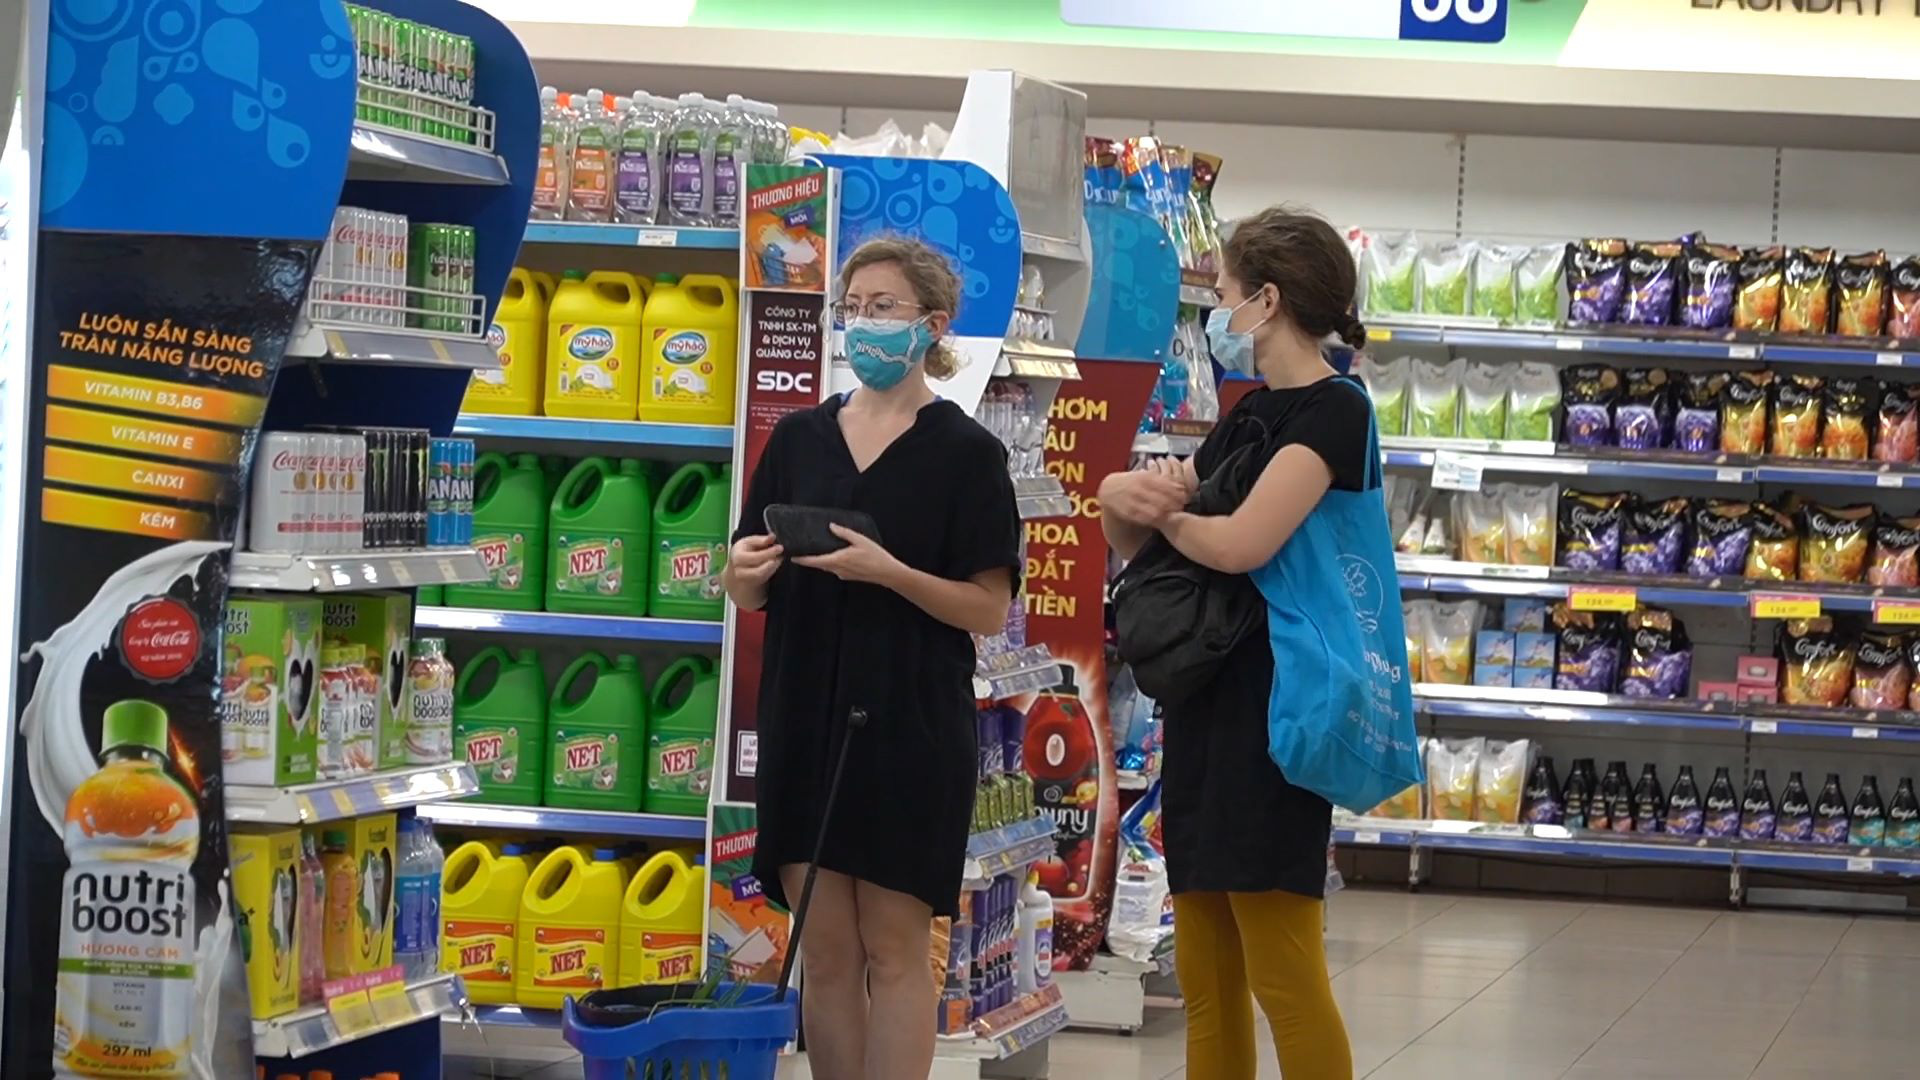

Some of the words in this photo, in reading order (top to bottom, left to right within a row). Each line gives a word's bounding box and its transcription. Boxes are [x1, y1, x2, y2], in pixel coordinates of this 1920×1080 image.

[798, 308, 811, 319] TY
[79, 312, 139, 337] LUÔN
[192, 327, 252, 354] SÀNG
[758, 321, 785, 332] TNHH
[786, 321, 817, 333] SX-TM
[762, 335, 771, 344] &
[772, 335, 796, 347] DỊCH
[793, 347, 816, 360] CÁO
[60, 332, 117, 355] TRÀN
[121, 340, 183, 366] NĂNG
[188, 351, 264, 378] LƯỢNG
[84, 380, 152, 402] VITAMIN
[155, 391, 204, 410] B3,B6
[756, 370, 813, 394] SDC
[1048, 396, 1108, 422] HƠM
[111, 426, 179, 448] VITAMIN
[182, 436, 194, 450] E
[1043, 425, 1076, 452] ÂU
[132, 469, 185, 490] CANXI
[1046, 460, 1085, 483] ƠN
[1025, 522, 1080, 546] HOA
[1812, 513, 1859, 539] Comfort
[569, 549, 607, 576] NET
[672, 552, 710, 580] NET
[1025, 586, 1077, 618] TIỀN
[1794, 637, 1837, 662] Comfort
[467, 736, 503, 763] NET
[566, 743, 603, 770] NET
[661, 748, 698, 775] NET
[73, 870, 184, 905] nutri
[72, 898, 187, 939] boost
[145, 946, 179, 959] CAM
[459, 943, 496, 969] NET
[550, 949, 586, 975] NET
[657, 954, 694, 980] NET
[103, 1044, 130, 1057] 297
[133, 1045, 152, 1058] ml
